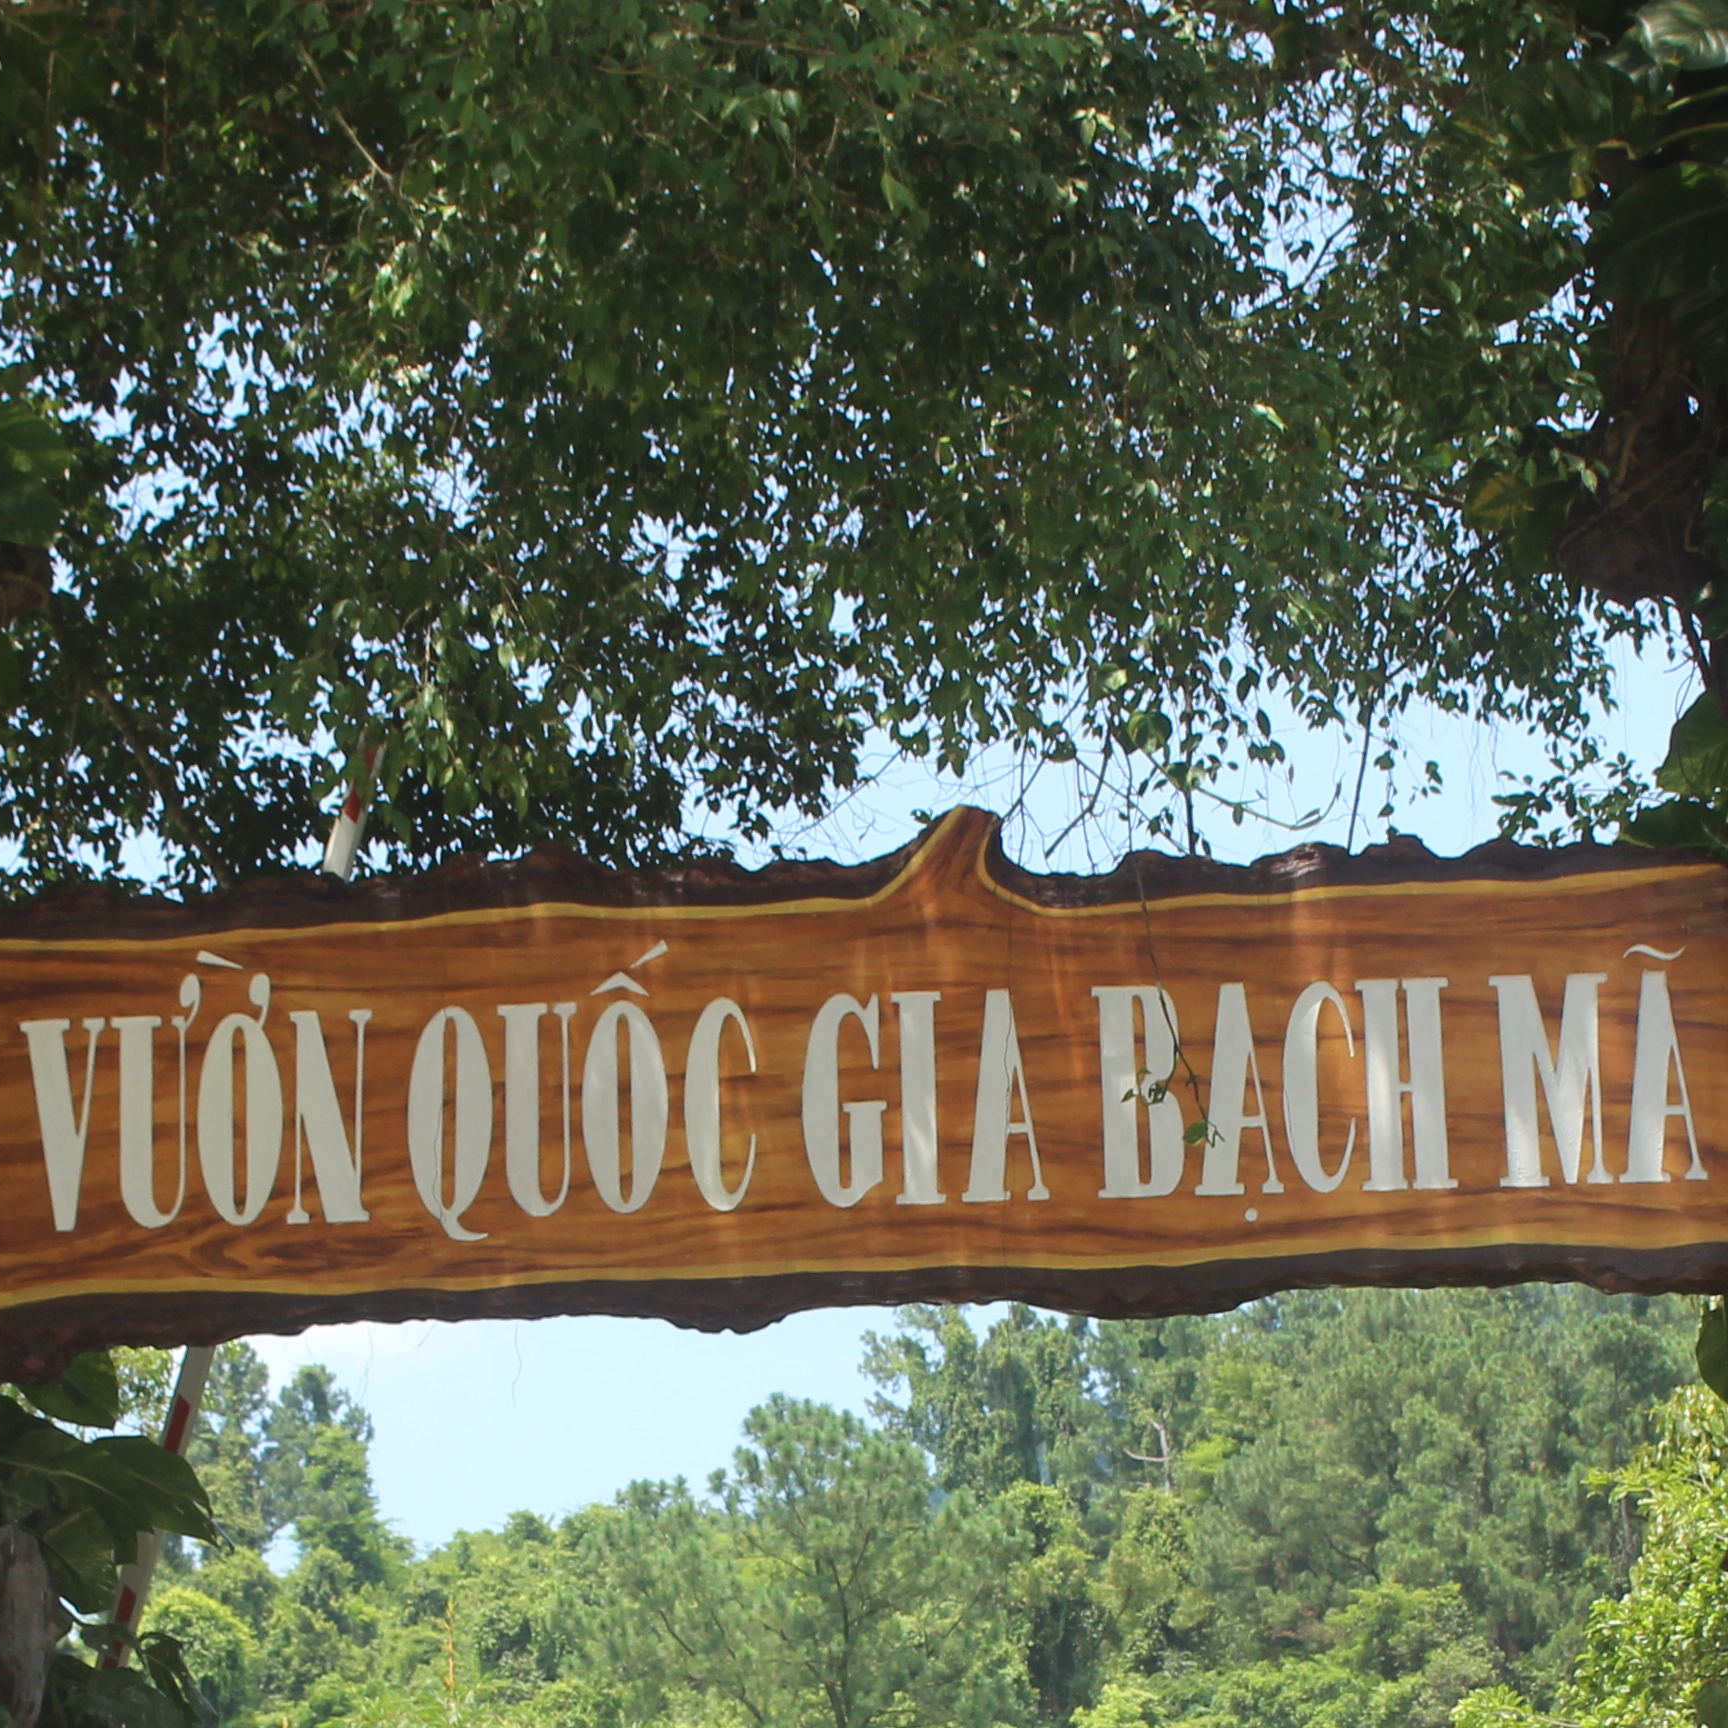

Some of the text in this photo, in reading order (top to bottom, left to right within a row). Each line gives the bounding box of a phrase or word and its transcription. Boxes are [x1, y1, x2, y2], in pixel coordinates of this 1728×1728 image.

[19, 940, 1708, 1241] VƯỜN QUỐC GIA BẠCH MÃ
